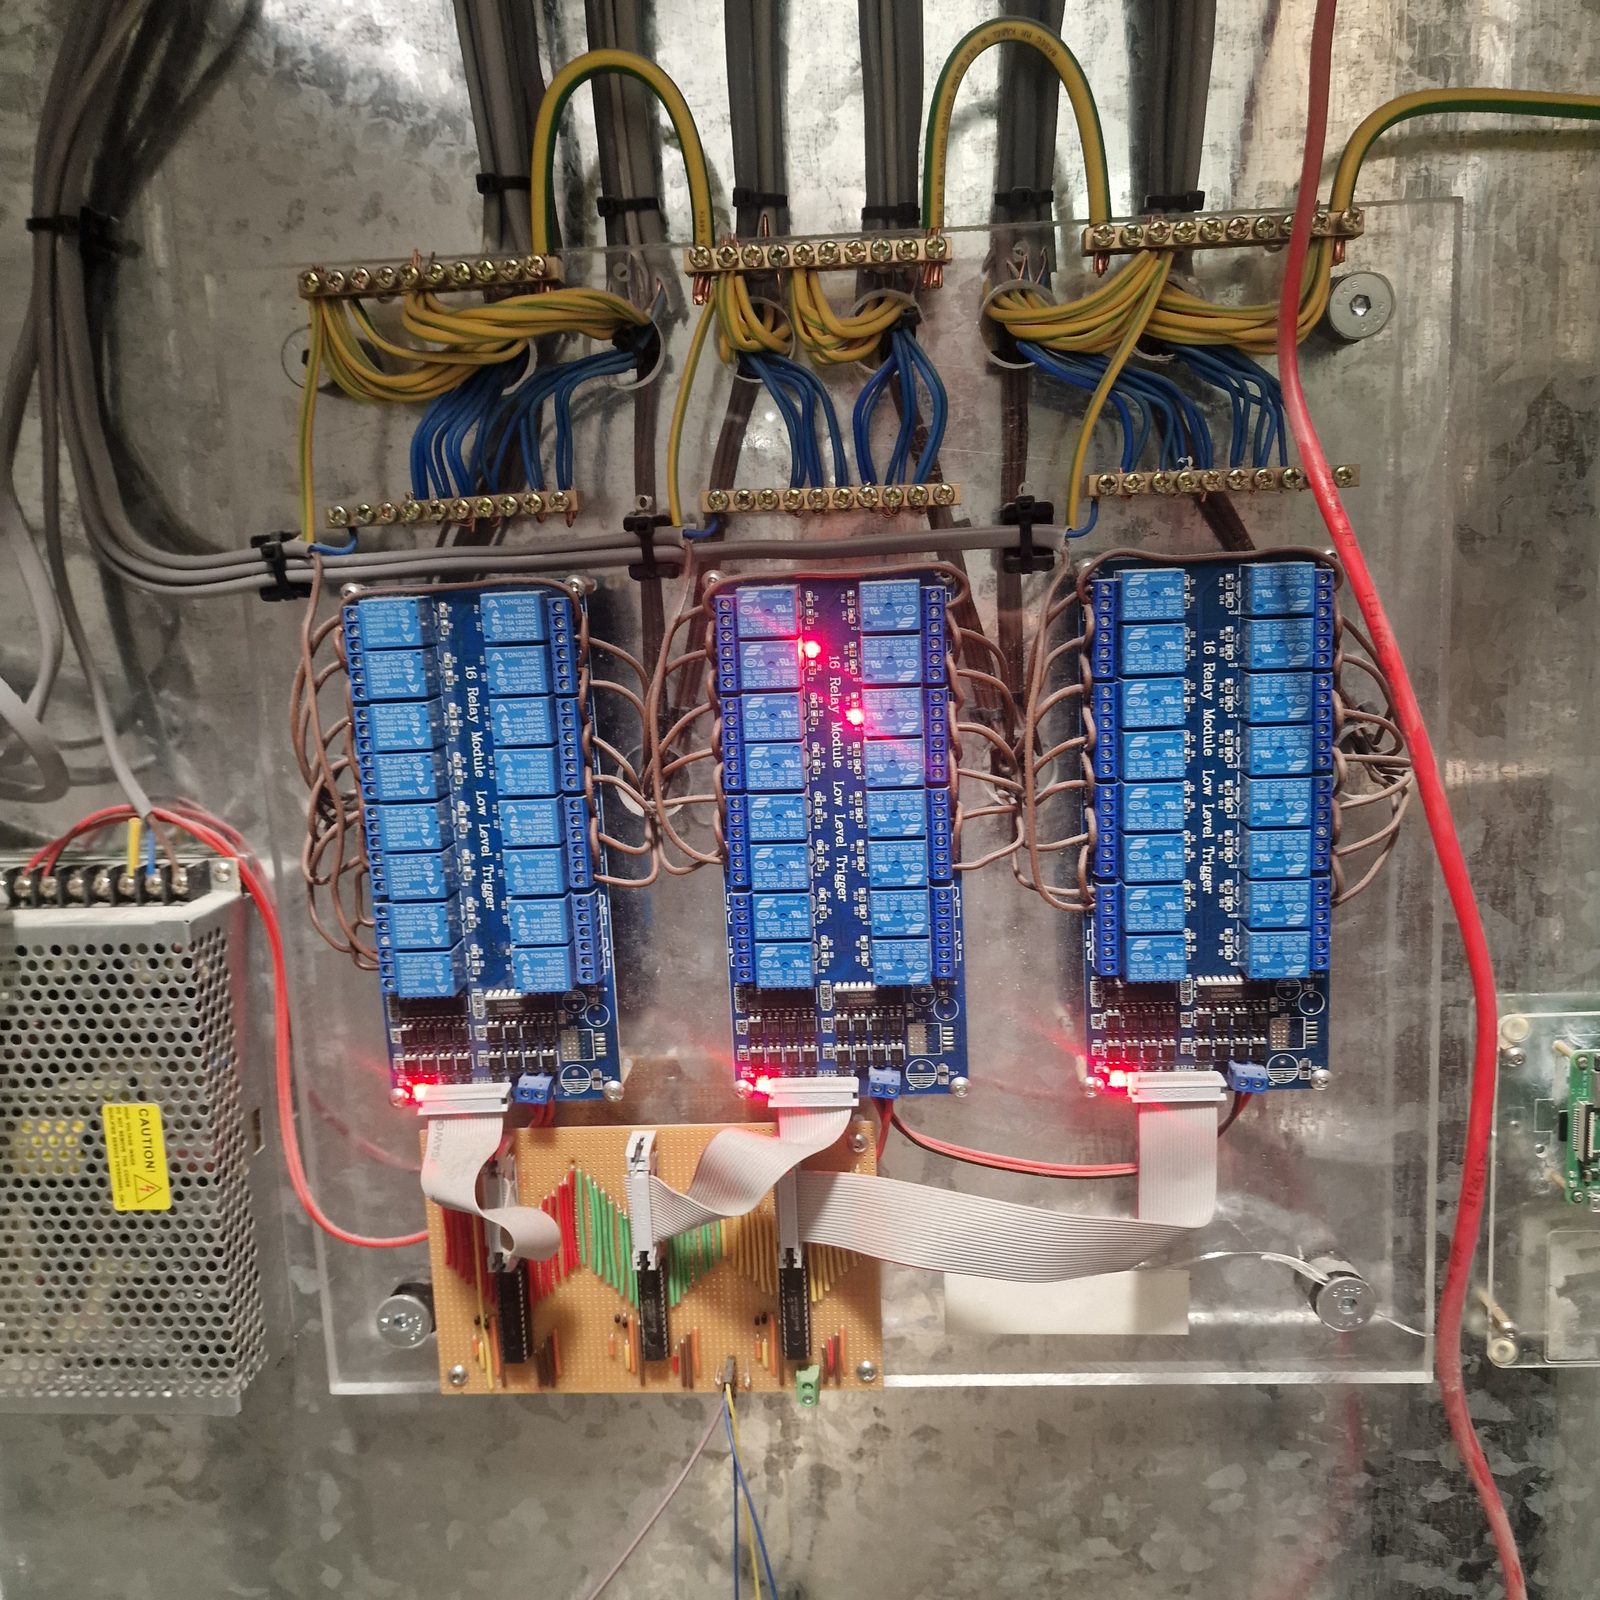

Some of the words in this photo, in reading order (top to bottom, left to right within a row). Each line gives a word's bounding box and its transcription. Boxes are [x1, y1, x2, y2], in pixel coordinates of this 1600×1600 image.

[829, 656, 839, 669] 16
[1203, 640, 1216, 654] 16
[465, 666, 477, 679] 16
[1200, 663, 1216, 700] Relay
[467, 687, 480, 724] Relay
[828, 677, 842, 714] Relay
[831, 722, 844, 768] Module
[1203, 708, 1216, 756] Module
[471, 731, 486, 777] Module
[833, 781, 845, 806] Low
[1202, 770, 1215, 796] Low
[476, 791, 488, 816] Low
[1202, 804, 1215, 838] Level
[479, 824, 493, 857] Level
[835, 814, 847, 847] Level
[481, 864, 495, 911] Trigger
[834, 855, 848, 902] Trigger
[1200, 846, 1215, 894] Trigger
[139, 1108, 156, 1172] CAUTION!
[115, 1161, 123, 1191] PERSONNEL
